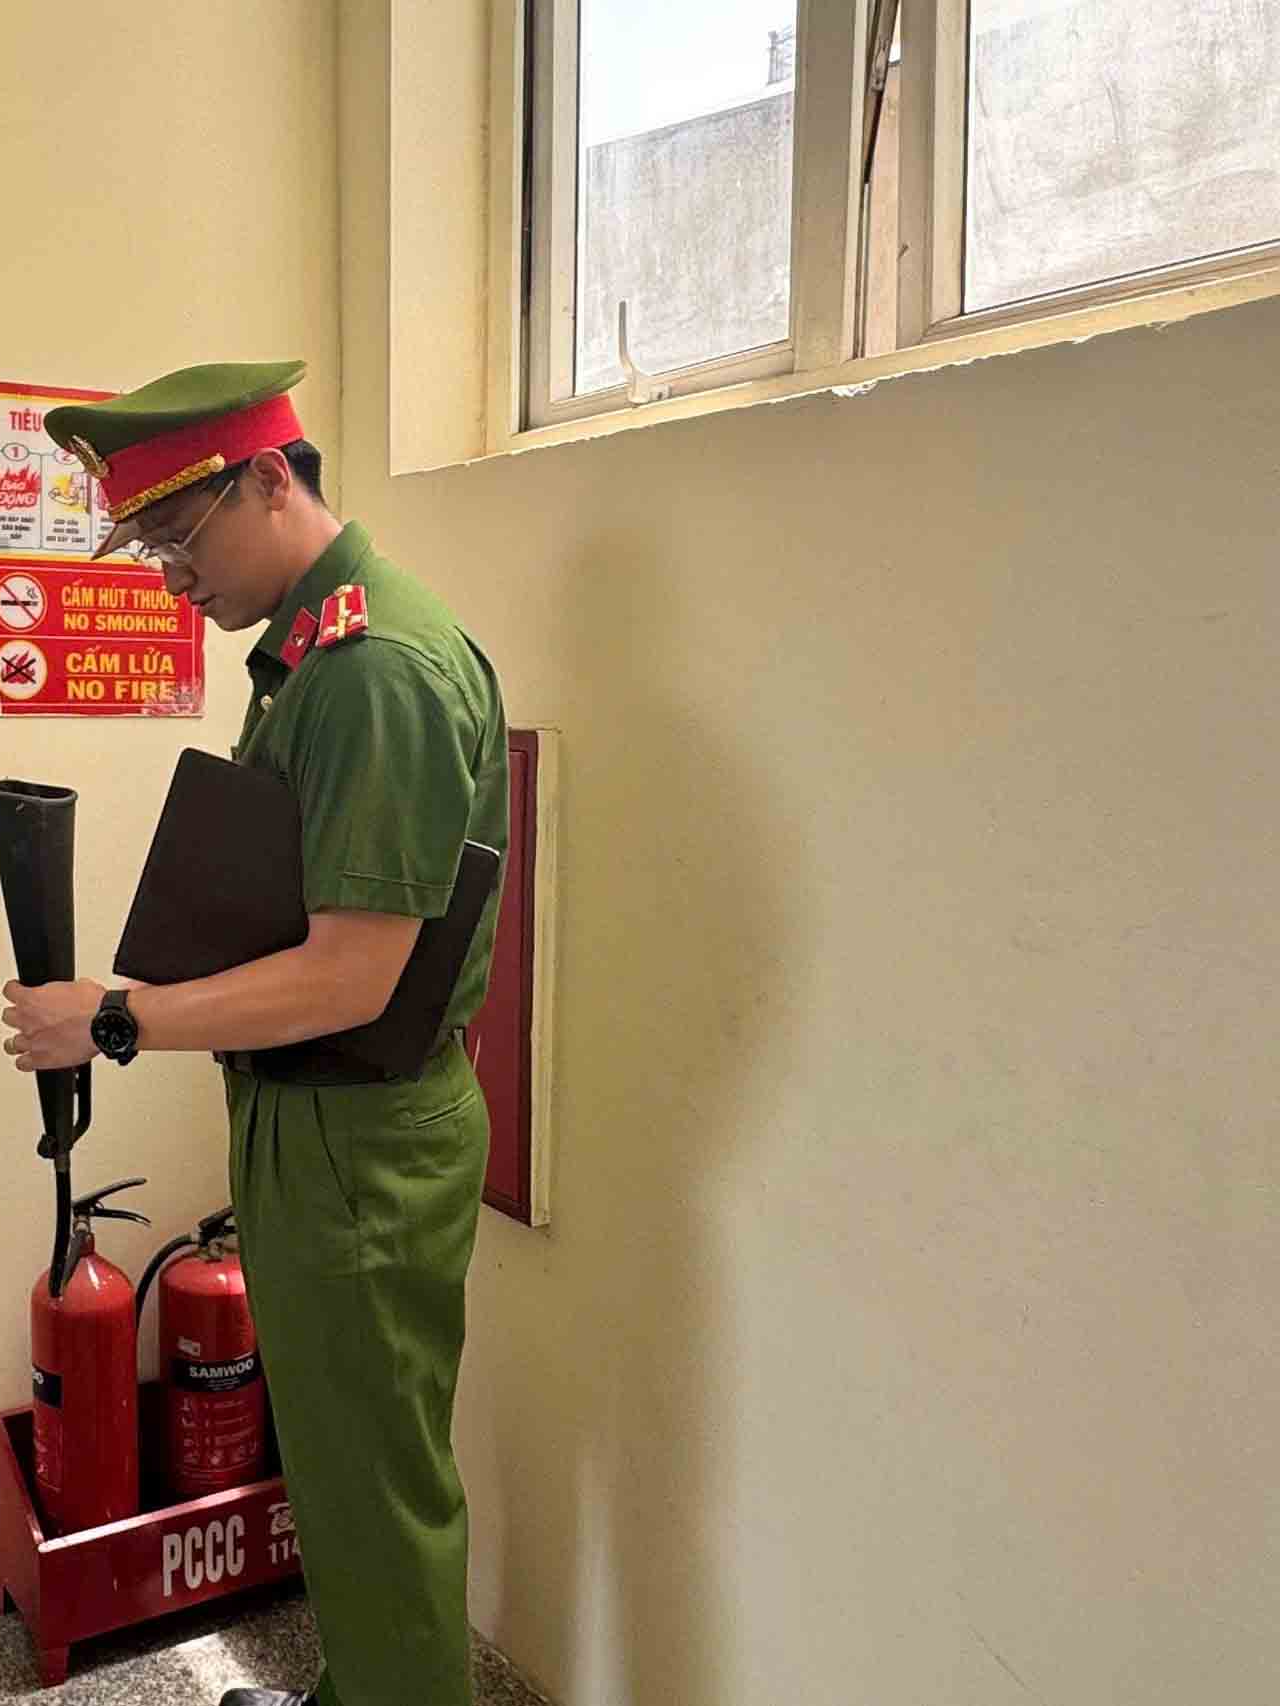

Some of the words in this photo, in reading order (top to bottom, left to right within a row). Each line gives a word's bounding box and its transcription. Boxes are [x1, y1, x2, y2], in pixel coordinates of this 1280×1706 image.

[11, 447, 19, 458] 1
[62, 579, 94, 608] CẤM
[98, 583, 128, 609] HÚT
[63, 612, 89, 631] NO
[95, 613, 178, 633] SMOKING
[66, 645, 120, 674] CẤM
[128, 647, 175, 675] LỬA
[67, 680, 105, 700] NO
[115, 680, 176, 702] FIRE
[189, 1358, 254, 1379] SAMWOO
[162, 1514, 245, 1598] PCCC
